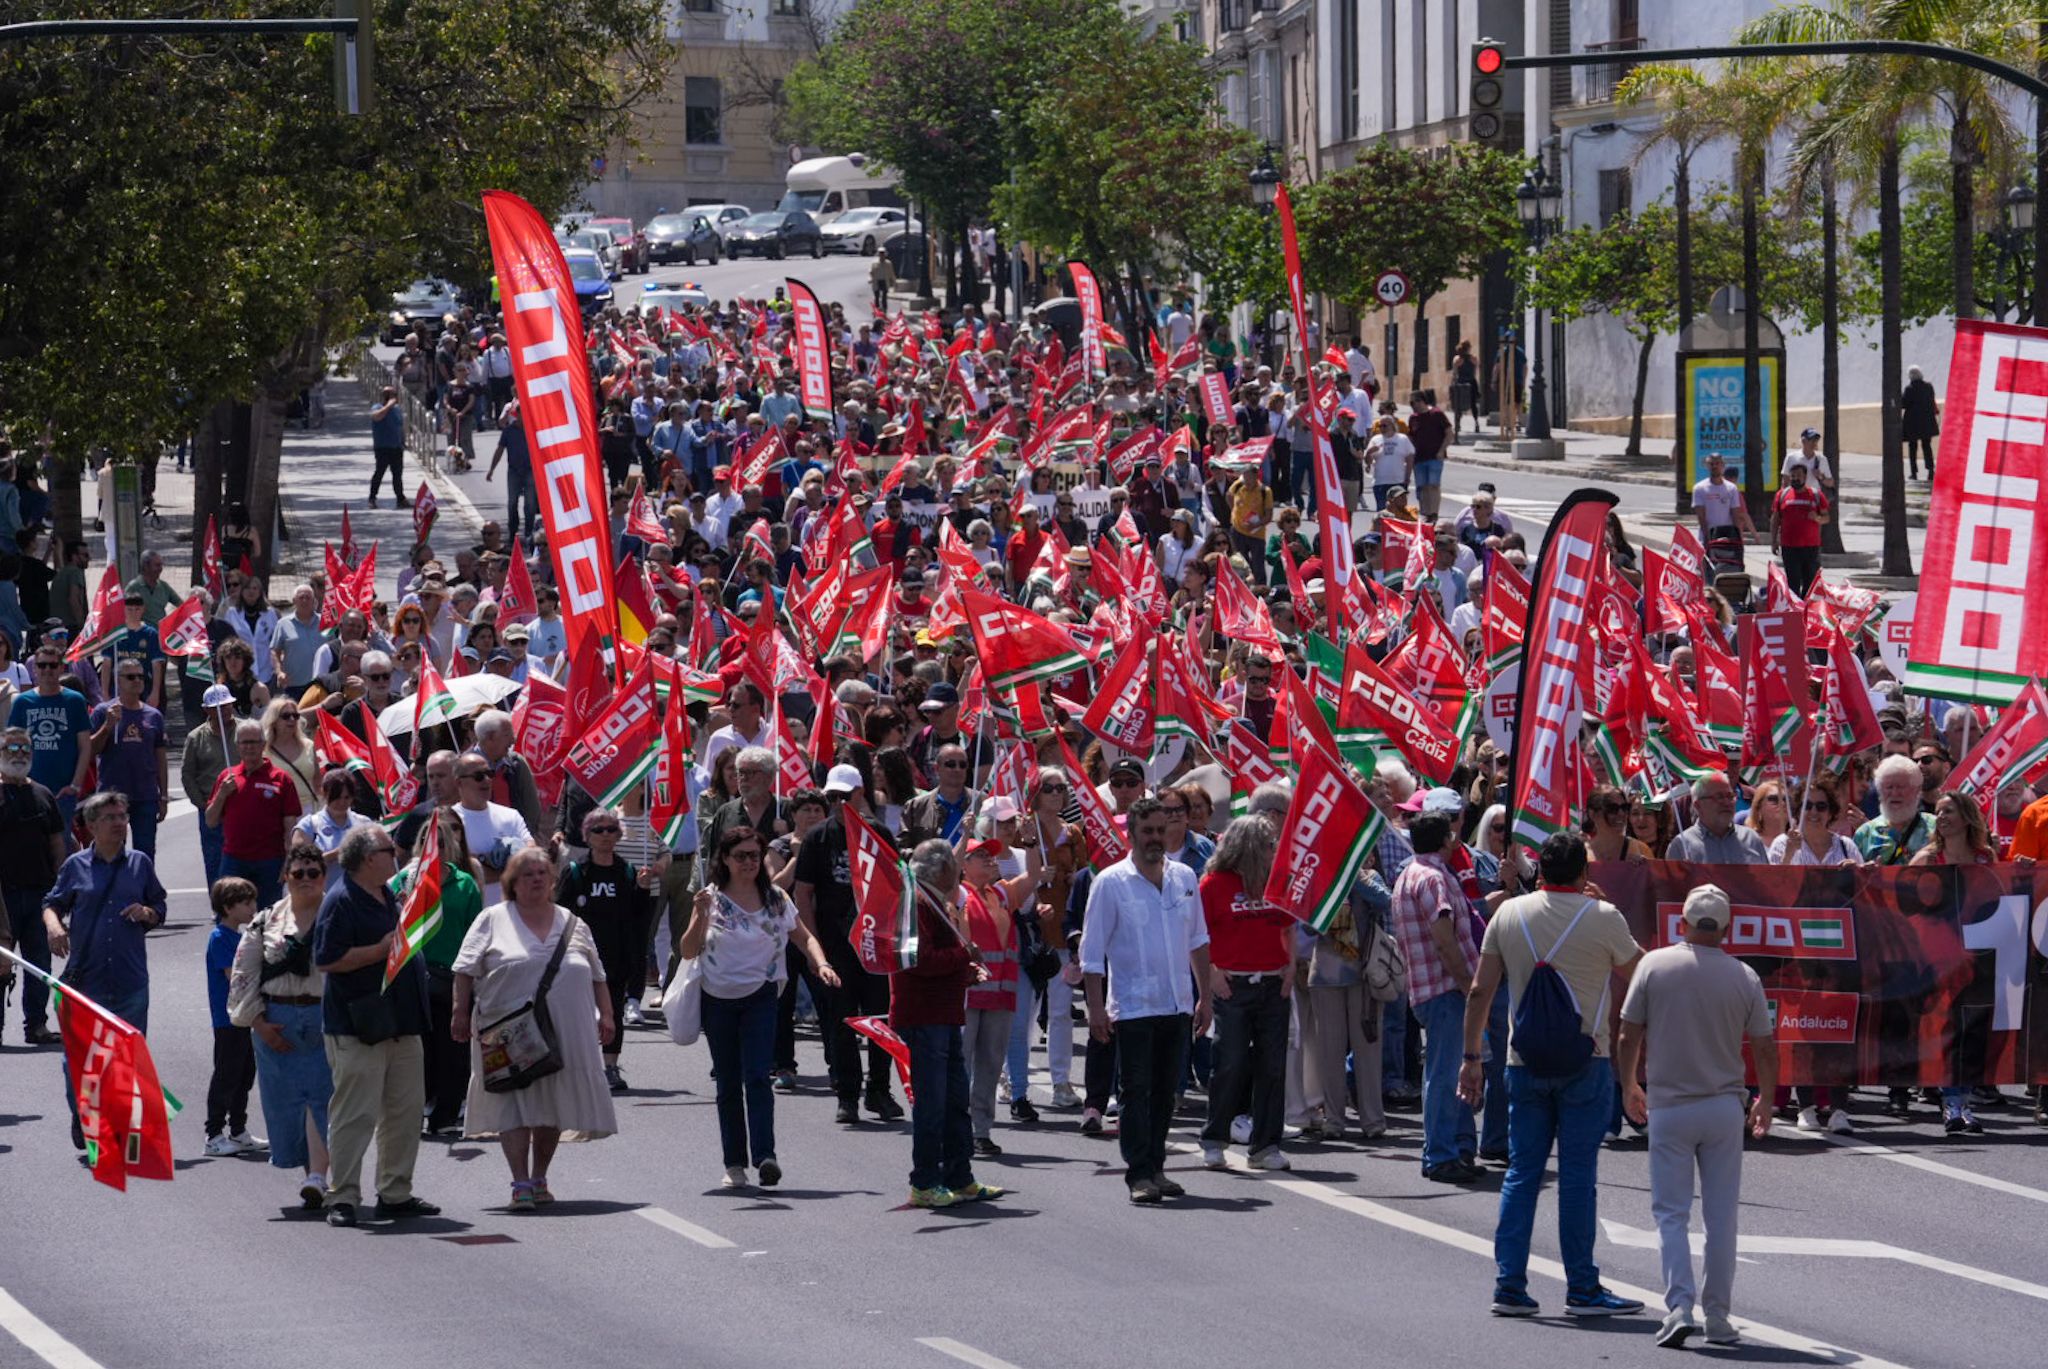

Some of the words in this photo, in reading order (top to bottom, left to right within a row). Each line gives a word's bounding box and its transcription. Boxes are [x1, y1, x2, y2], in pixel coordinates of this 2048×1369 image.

[1380, 282, 1402, 294] 40
[1700, 376, 1742, 398] NO
[1700, 404, 1742, 416] PERO
[1701, 417, 1741, 432] HAY
[1939, 331, 2048, 674] CCOO
[1530, 532, 1593, 789] CCOO
[26, 707, 68, 725] ITALIA
[34, 741, 59, 750] ROMA
[1405, 729, 1448, 763] Cádiz
[1781, 1015, 1848, 1030] Andalucía
